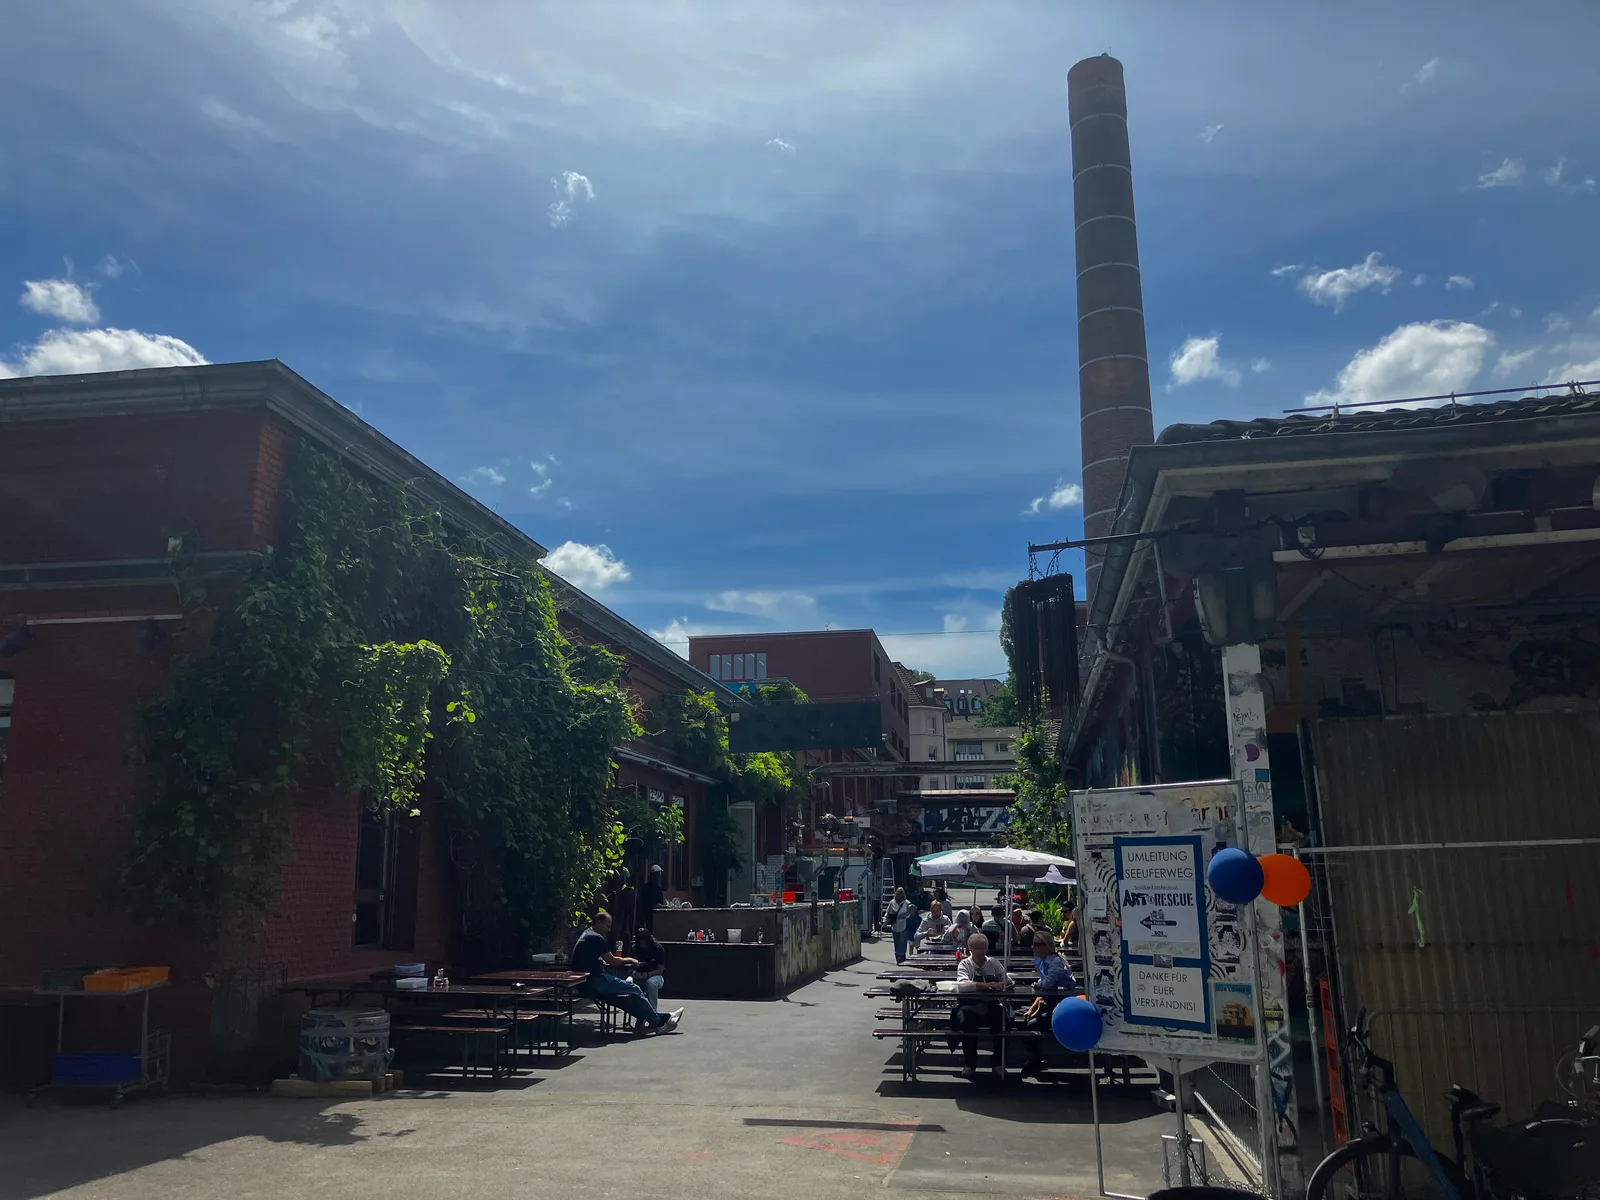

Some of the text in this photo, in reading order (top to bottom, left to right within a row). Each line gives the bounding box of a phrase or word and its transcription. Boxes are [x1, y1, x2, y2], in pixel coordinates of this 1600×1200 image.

[1127, 850, 1188, 862] UMLEITUNG
[1125, 867, 1193, 879] SEEUFERWEG
[1153, 893, 1194, 907] RESCUE
[1139, 970, 1188, 983] DANKE FÜR
[1153, 985, 1175, 995] EUER
[1134, 997, 1196, 1011] VERSTÄNDNIS!
